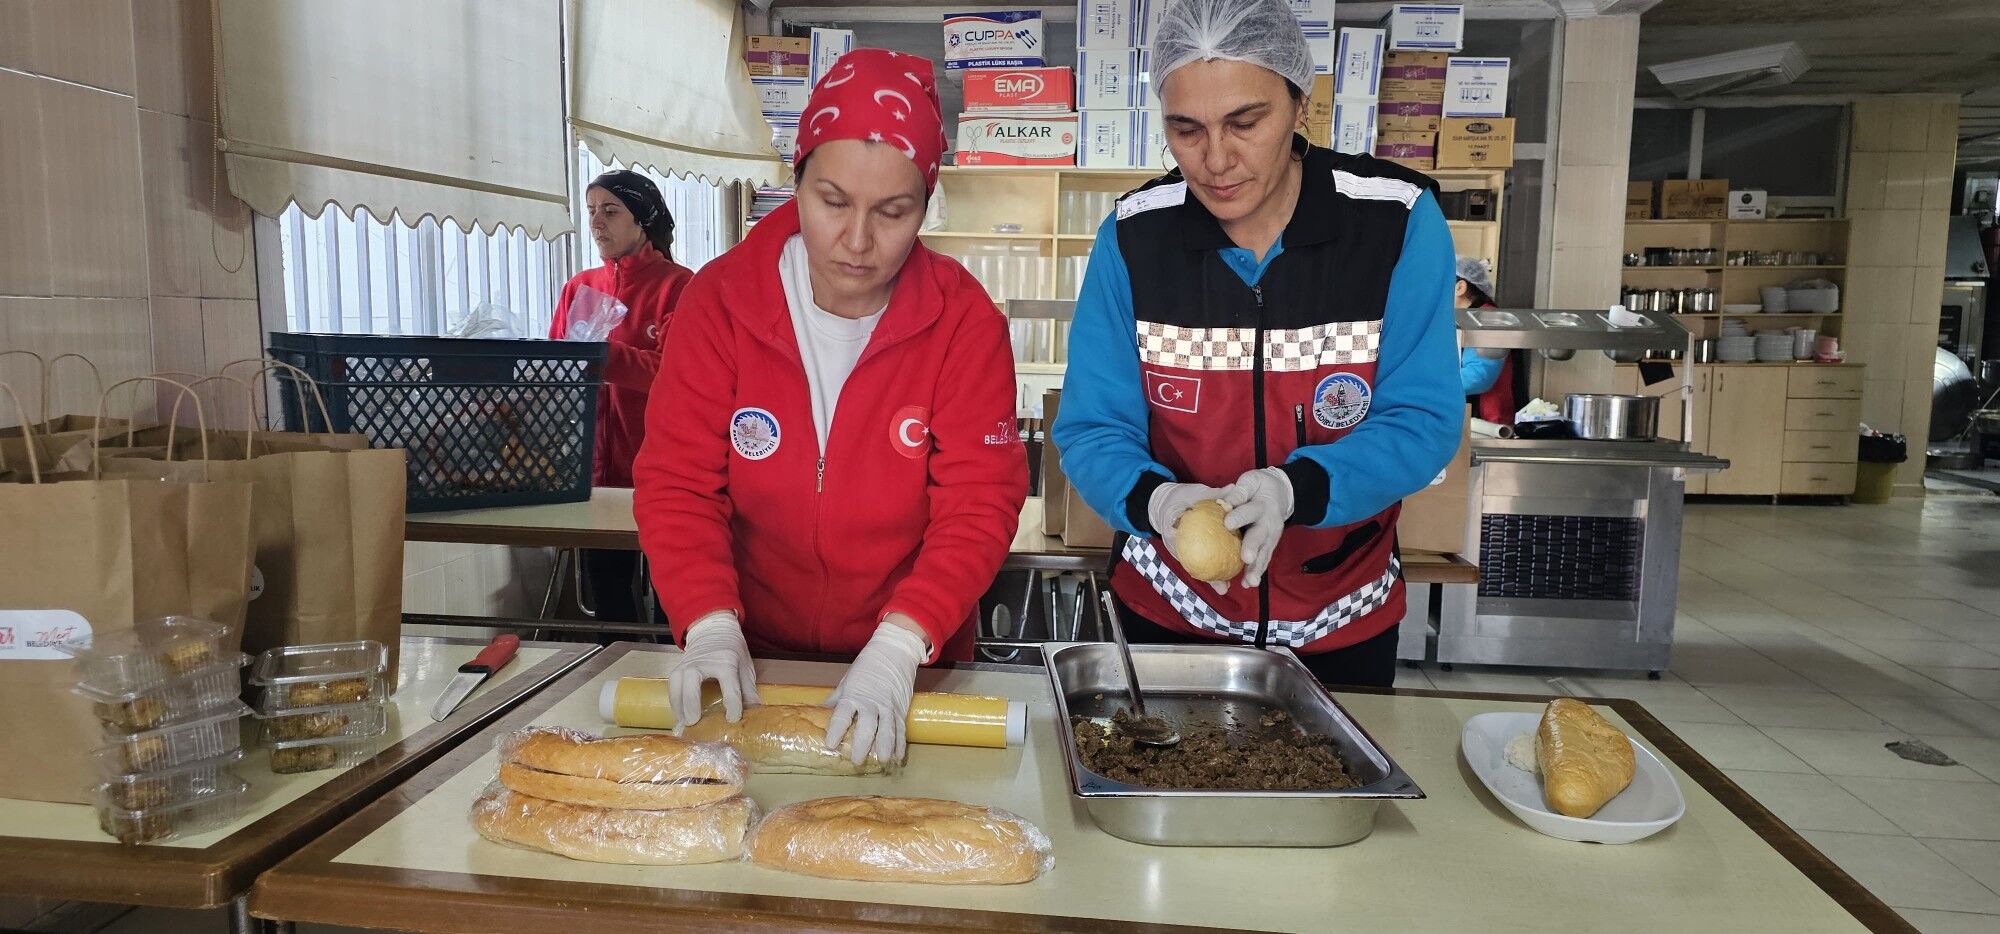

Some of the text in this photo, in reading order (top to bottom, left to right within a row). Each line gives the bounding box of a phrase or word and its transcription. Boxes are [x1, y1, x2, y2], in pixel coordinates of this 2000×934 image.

[965, 29, 1014, 42] CUPPA
[994, 79, 1035, 93] EMA
[995, 126, 1051, 138] ALKAR
